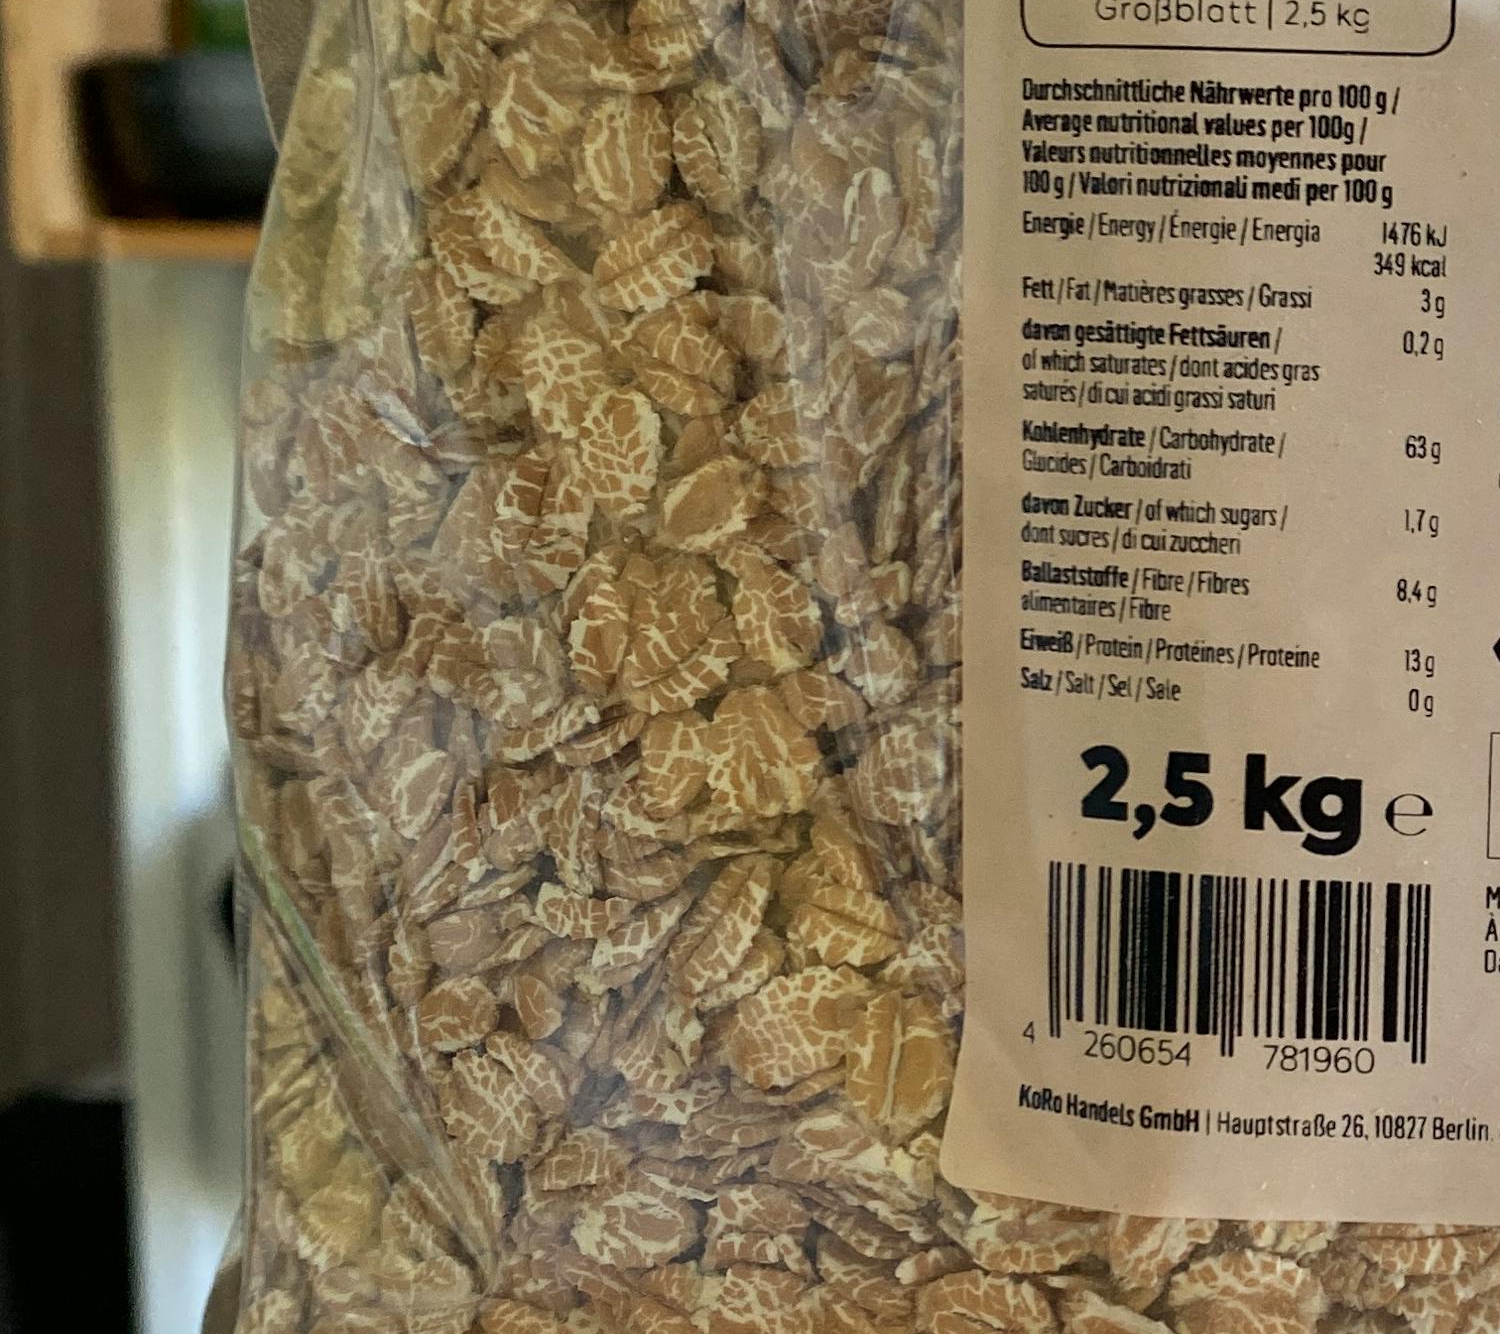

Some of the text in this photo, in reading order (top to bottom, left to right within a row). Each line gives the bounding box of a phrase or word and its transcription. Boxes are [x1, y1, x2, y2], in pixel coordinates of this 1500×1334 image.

[1285, 0, 1326, 28] 2,5
[1337, 3, 1369, 34] kg
[1022, 78, 1387, 115] Durchschnittliche Nährwerte pro 100 g
[1022, 108, 1354, 145] Average nutritional values per 100g
[1022, 140, 1387, 176] Valeurs nutritionnelles moyennes pour
[1023, 210, 1320, 248] Energie Energy Énergie Energia
[1383, 222, 1447, 247] 1476 kJ
[1374, 252, 1446, 278] 349 kcal
[1403, 331, 1444, 360] 0,2 g
[1405, 435, 1440, 464] 63 g
[1397, 579, 1437, 608] 8,4 g
[1405, 649, 1434, 678] 13 g
[1080, 745, 1213, 840] 2,5
[1244, 753, 1362, 856] kg
[1023, 1021, 1375, 1074] 4 260654 781960
[1019, 1084, 1062, 1113] KoRo
[1066, 1093, 1135, 1127] Handels
[1139, 1105, 1199, 1132] GmbH
[1217, 1112, 1336, 1138] Hauptstraße
[1342, 1114, 1368, 1140] 26,
[1375, 1115, 1427, 1139] 10827
